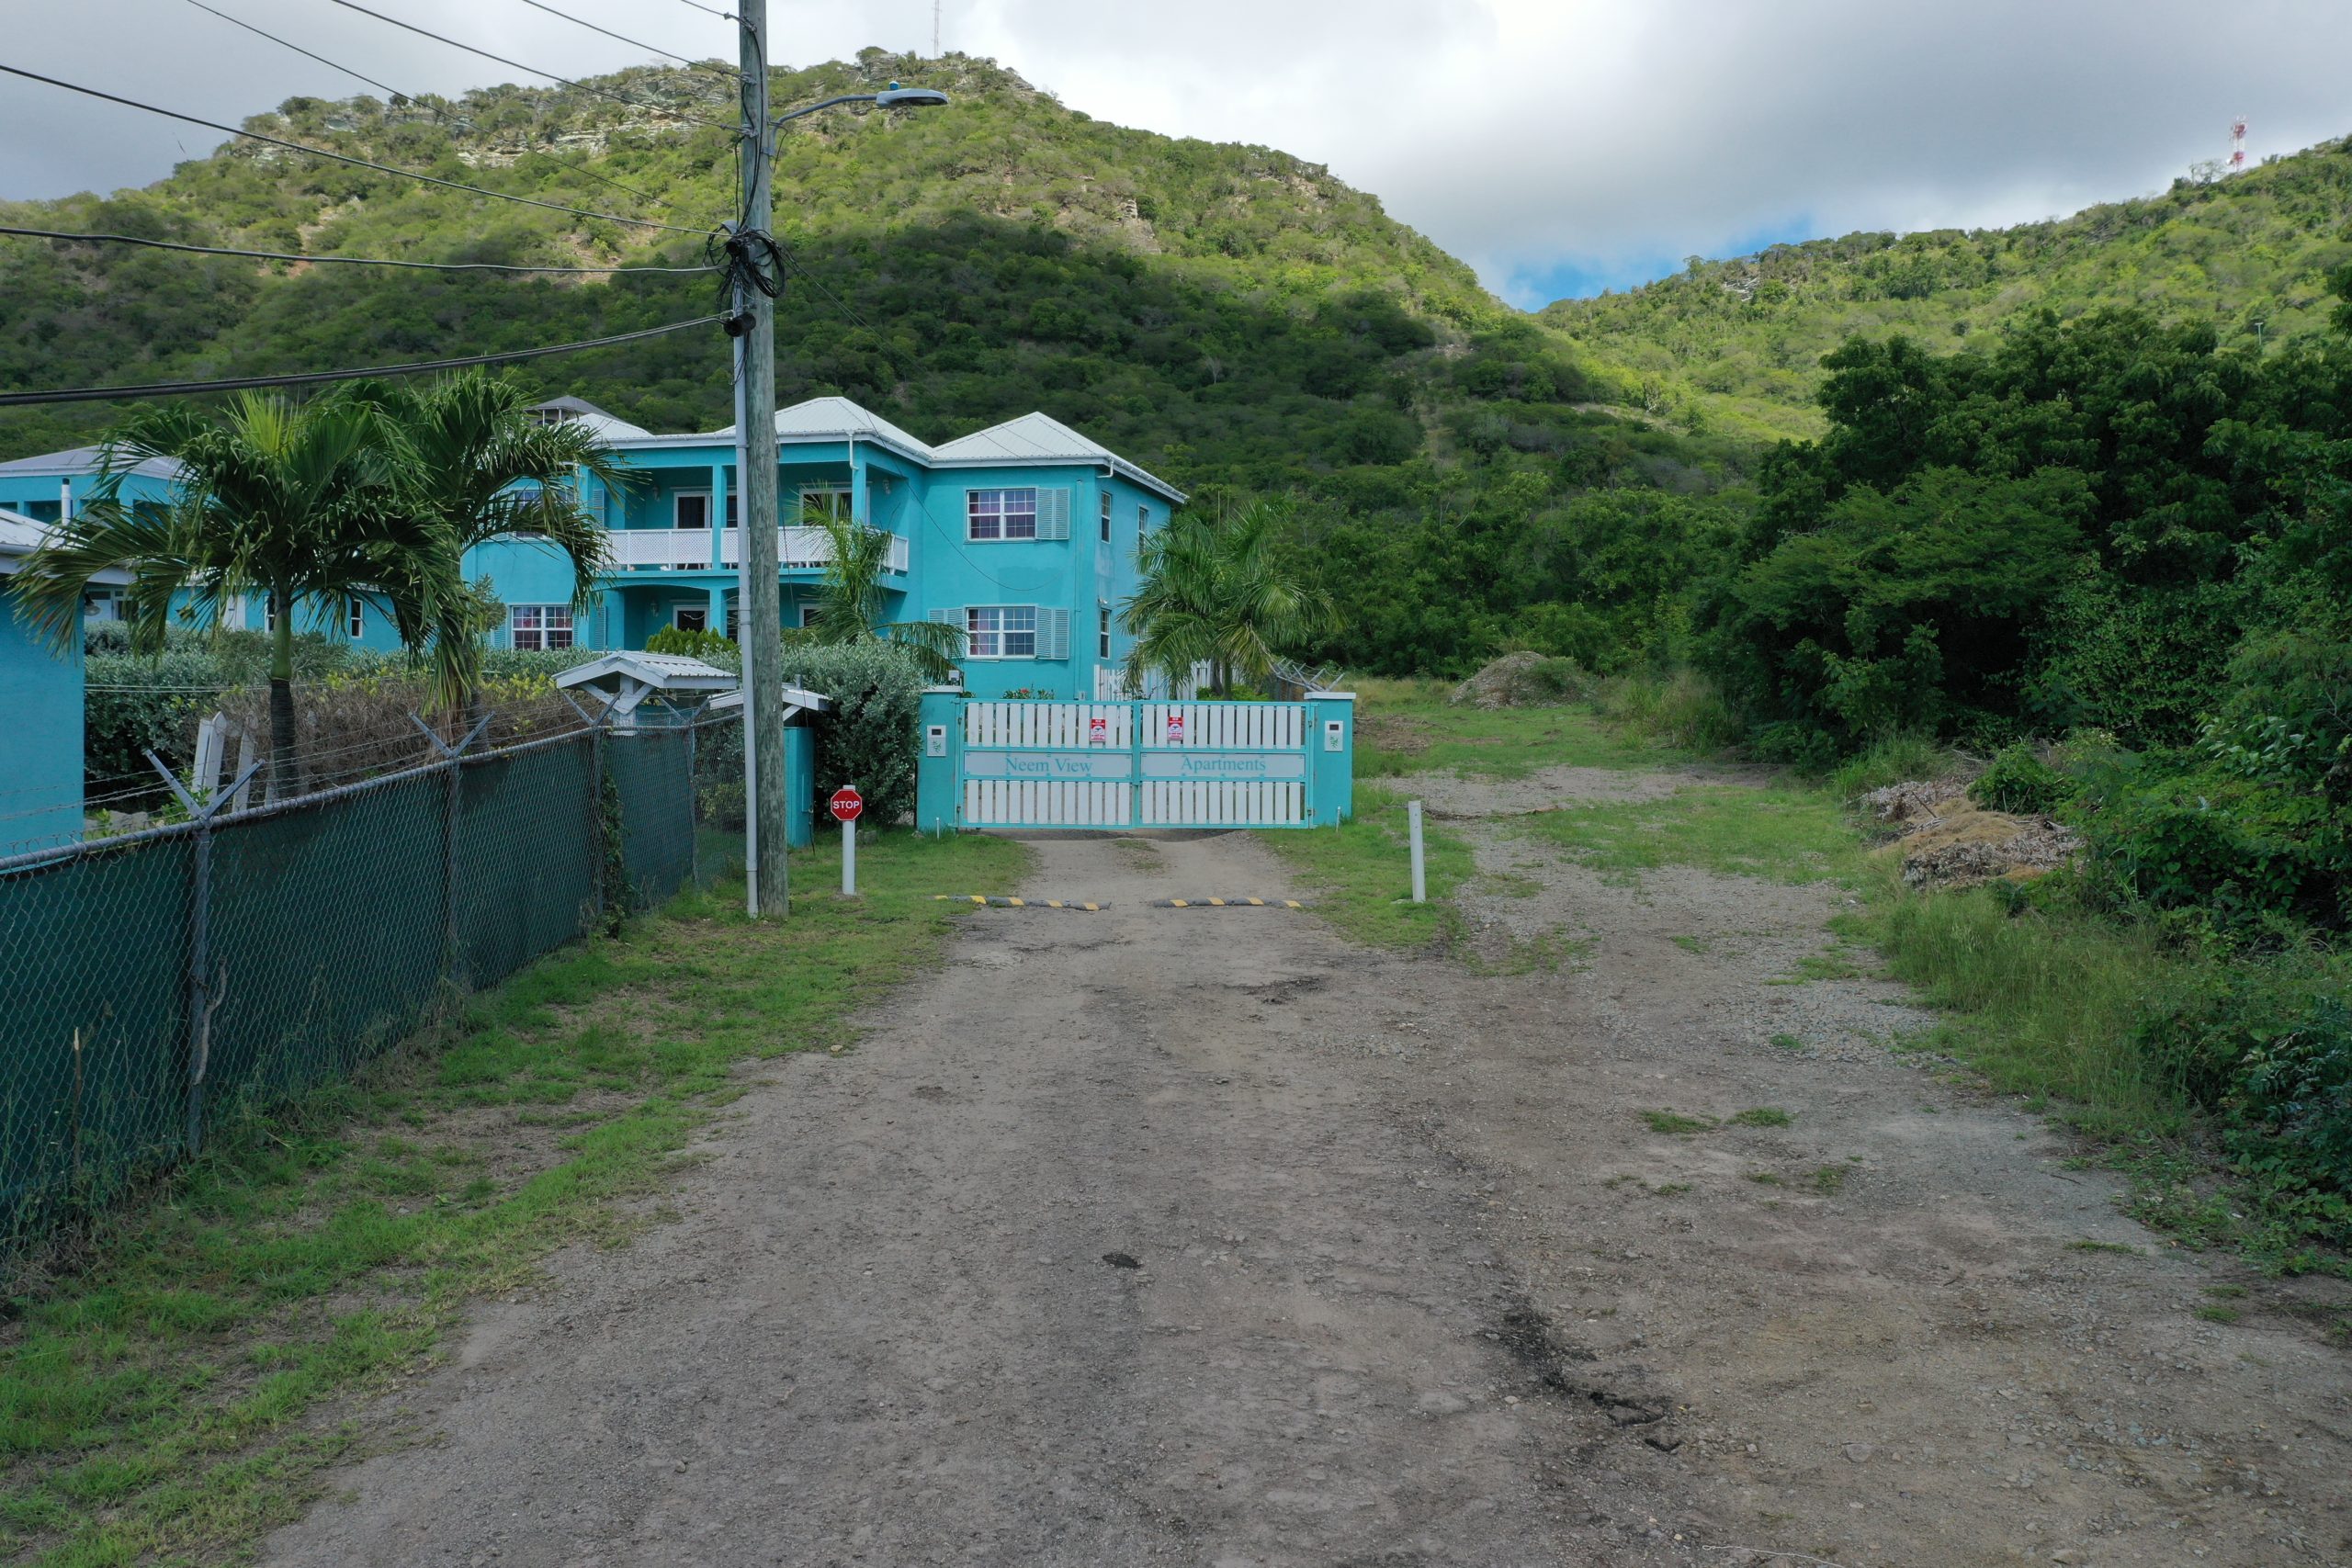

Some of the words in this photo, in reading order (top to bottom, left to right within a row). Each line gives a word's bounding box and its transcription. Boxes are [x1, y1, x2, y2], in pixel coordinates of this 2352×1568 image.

[1005, 758, 1049, 772] Neem
[1055, 758, 1092, 772] View
[1181, 757, 1266, 773] Apartments
[832, 800, 860, 809] STOP
